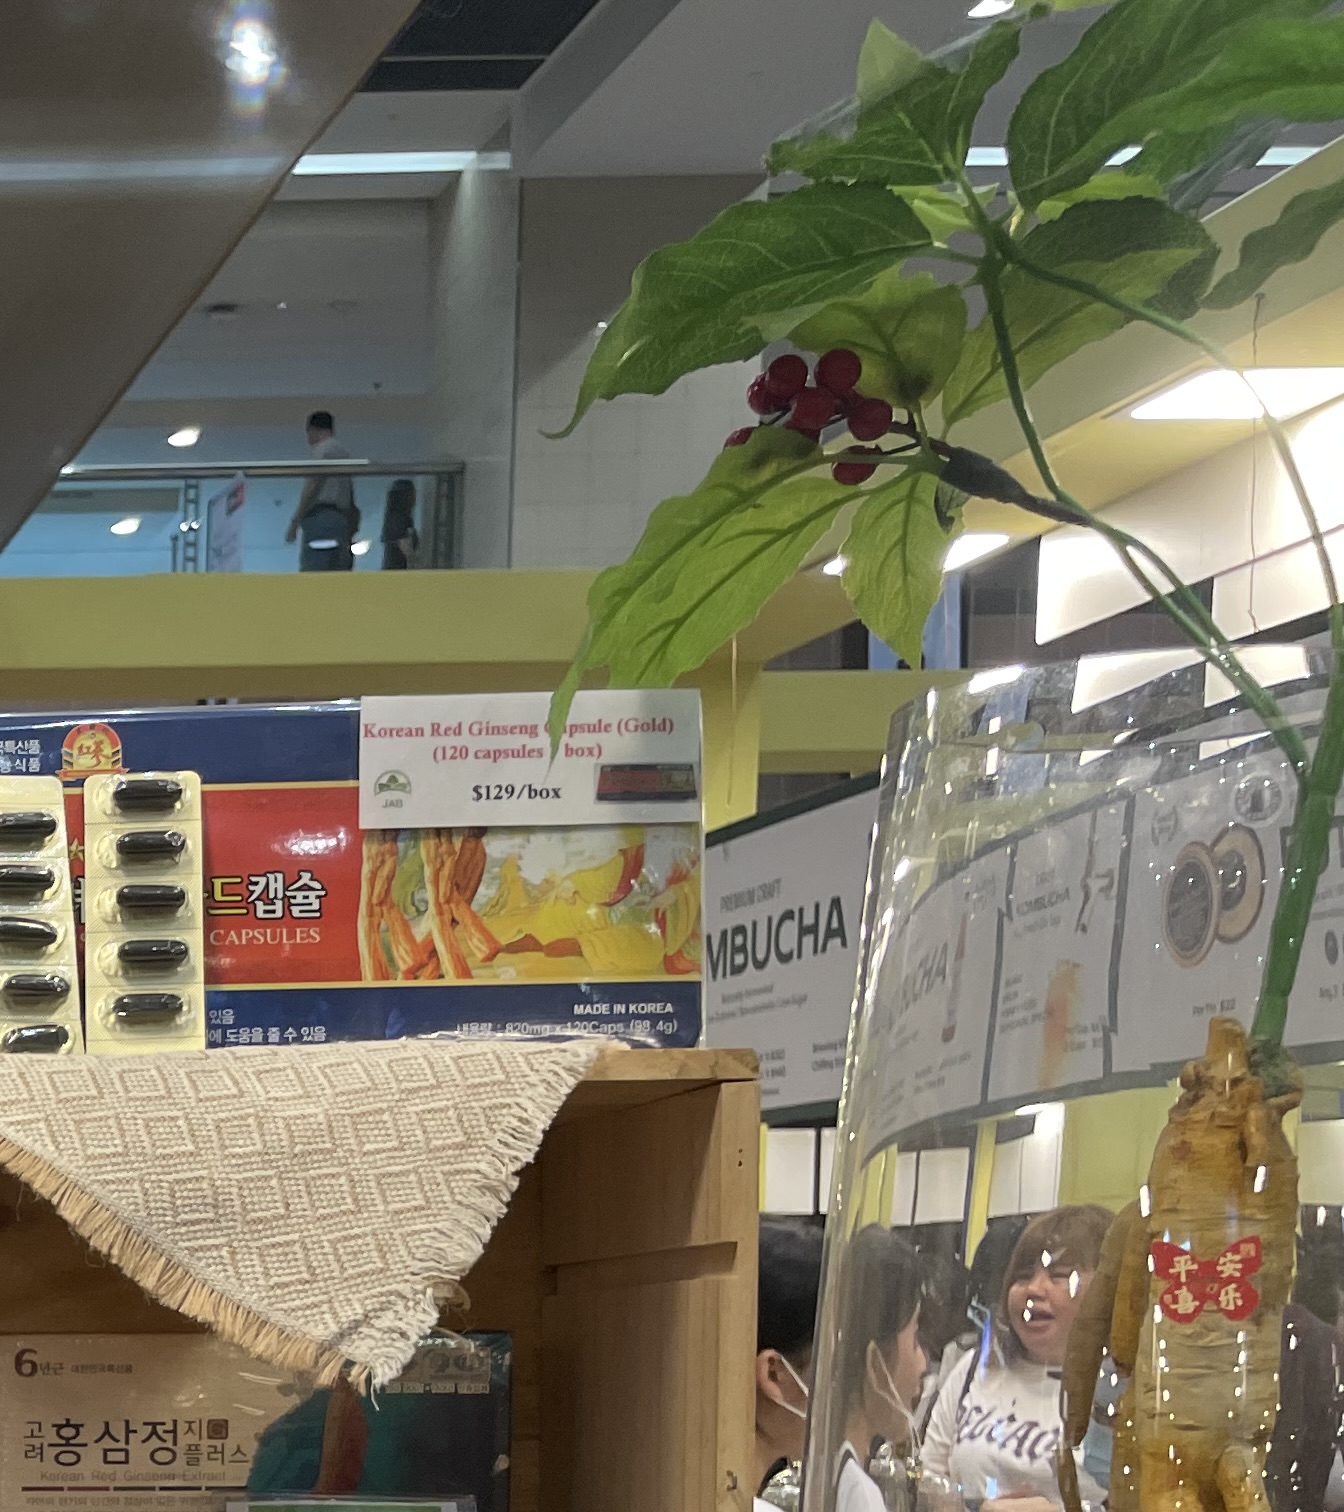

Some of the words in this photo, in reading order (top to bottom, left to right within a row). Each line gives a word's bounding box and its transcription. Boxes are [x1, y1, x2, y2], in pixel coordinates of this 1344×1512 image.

[363, 723, 424, 738] Korean
[431, 723, 462, 737] Red
[469, 720, 538, 738] Ginseng
[545, 720, 612, 736] psule
[617, 717, 674, 736] (Gold)
[433, 745, 468, 763] (120
[474, 744, 543, 762] capsules
[564, 742, 602, 760] box)
[472, 784, 561, 802] $129/box
[210, 927, 321, 947] CAPSULES
[706, 896, 848, 982] MBUCHA
[574, 1004, 610, 1015] MADE
[613, 1004, 625, 1014] IN
[629, 1003, 673, 1014] KOREA
